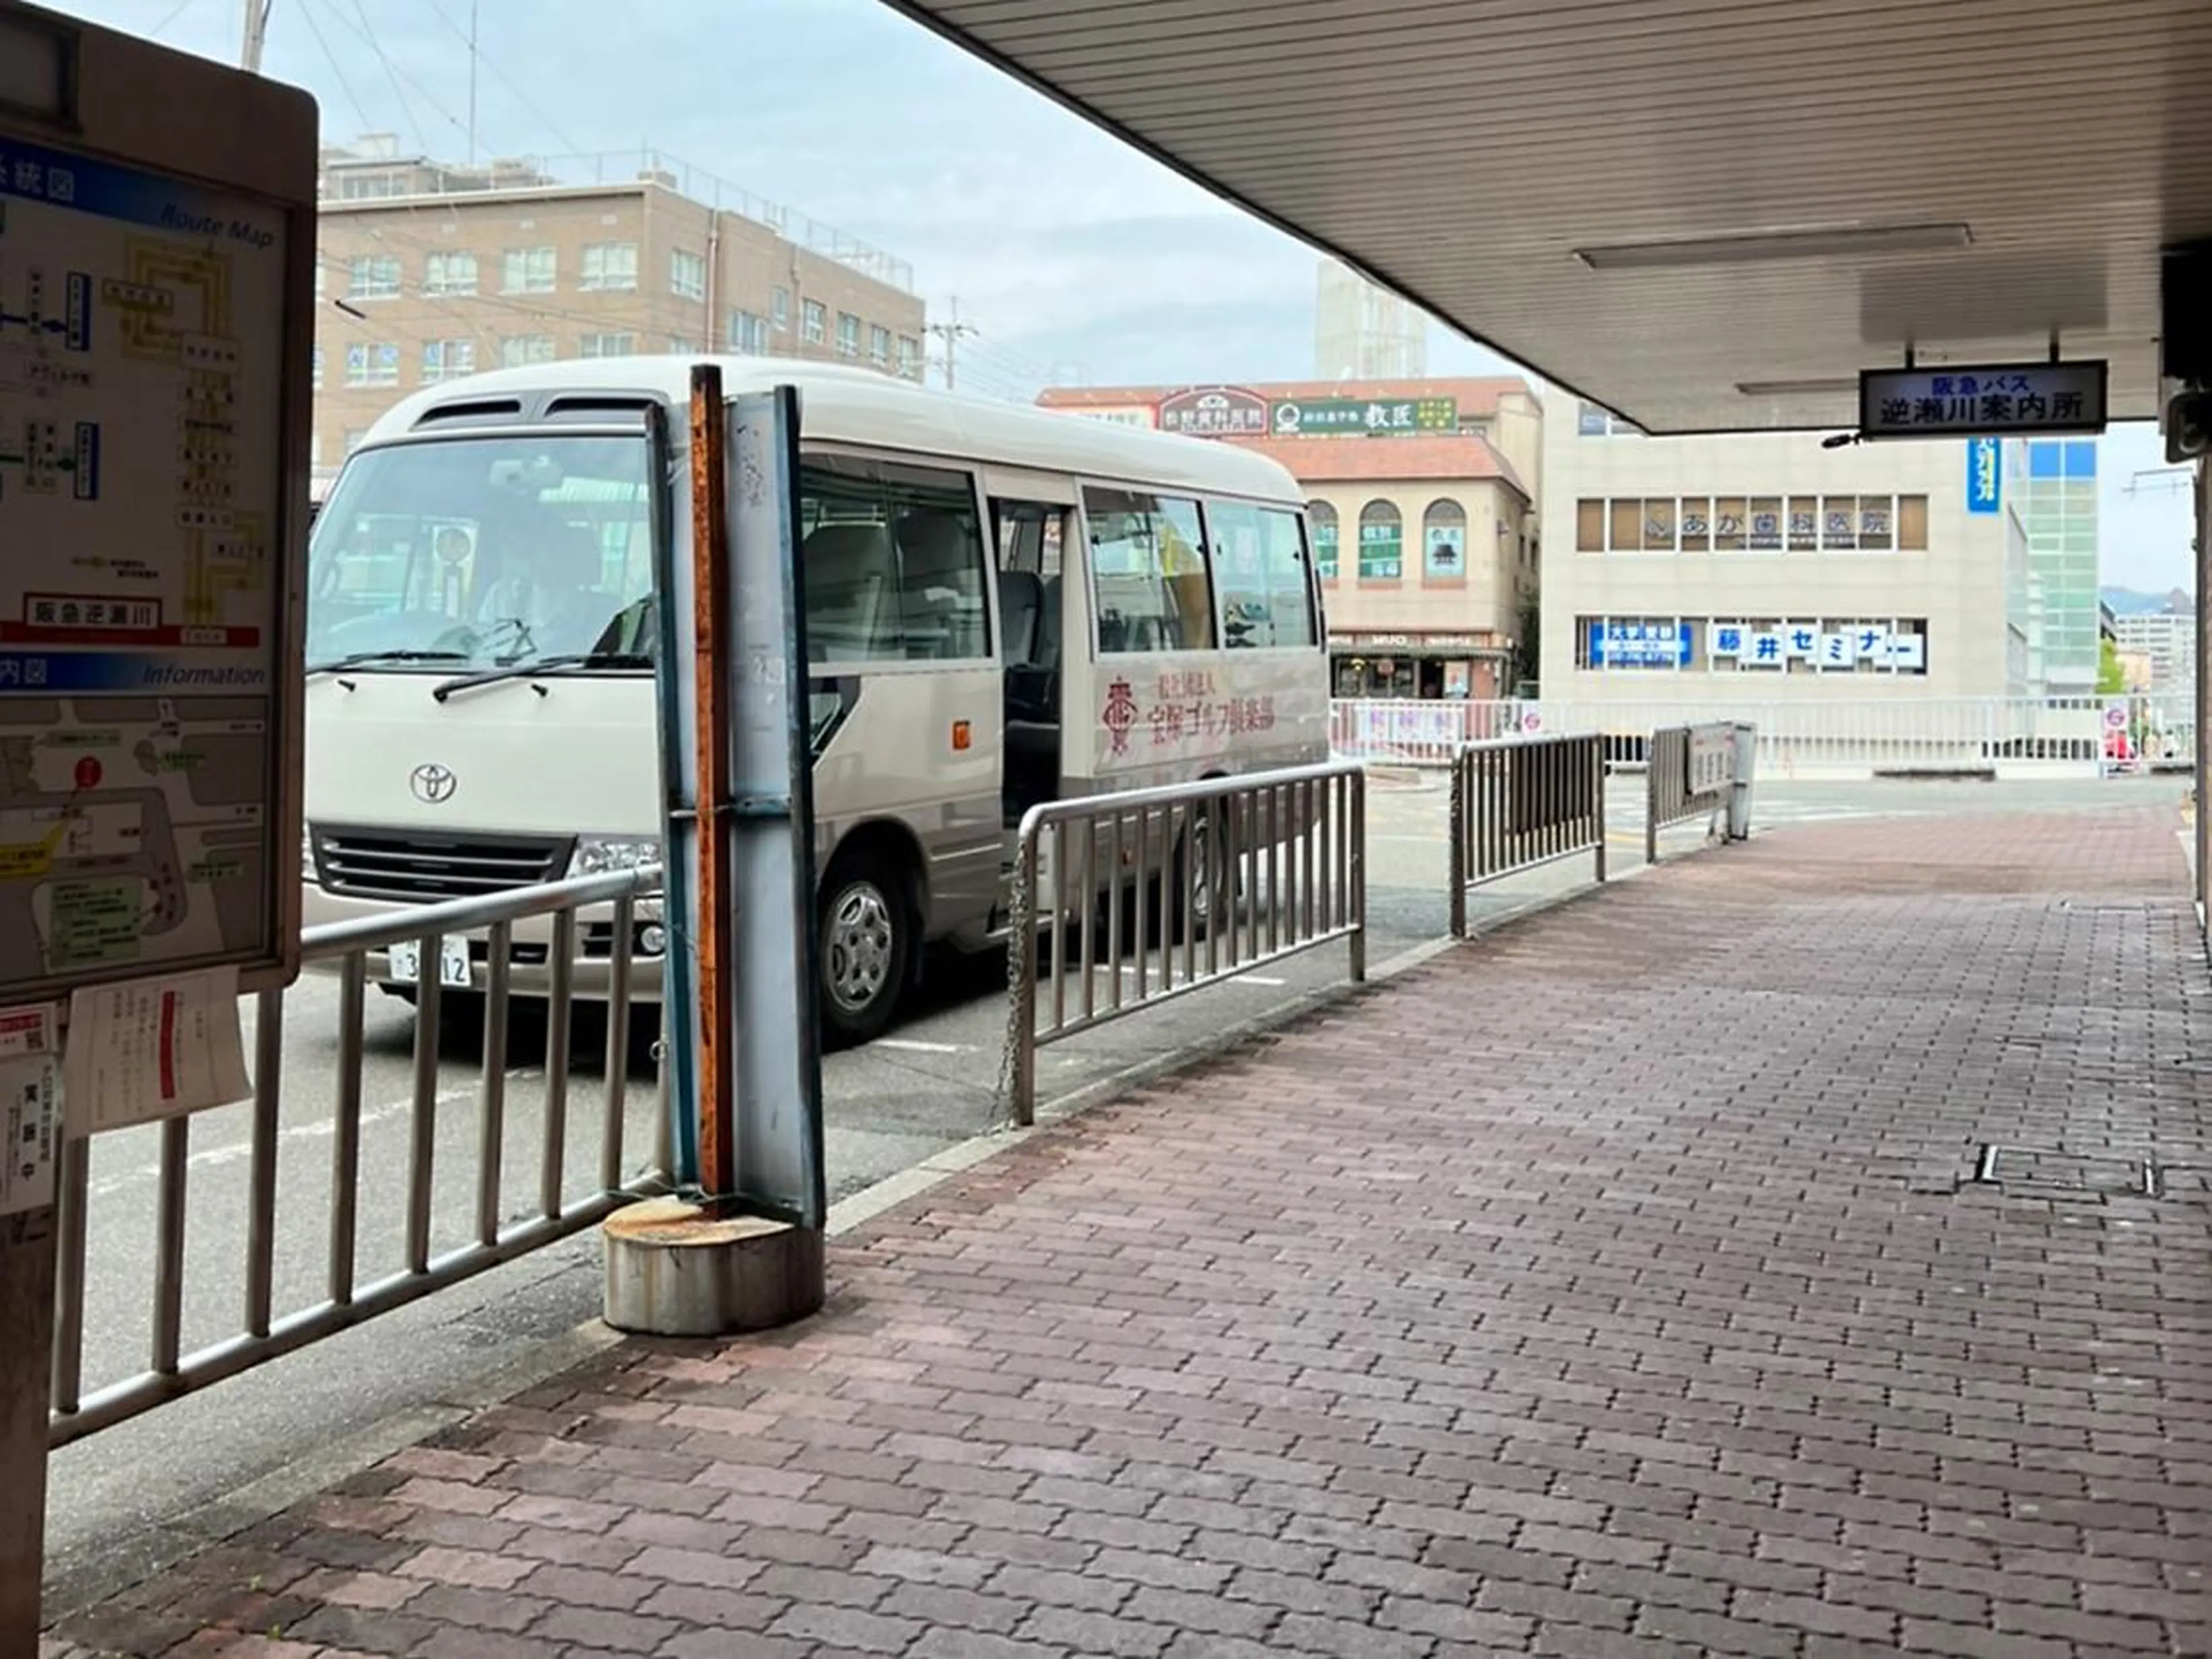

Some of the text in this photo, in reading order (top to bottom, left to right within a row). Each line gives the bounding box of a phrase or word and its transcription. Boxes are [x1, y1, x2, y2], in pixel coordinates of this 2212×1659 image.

[160, 203, 274, 250] Route Map
[1931, 375, 2030, 395] 阪急バス
[1880, 391, 2084, 426] 逆瀬川案内所
[35, 602, 151, 627] 阪急逆瀬川
[1717, 628, 1912, 661] 藤井セミナー
[143, 663, 265, 686] Information
